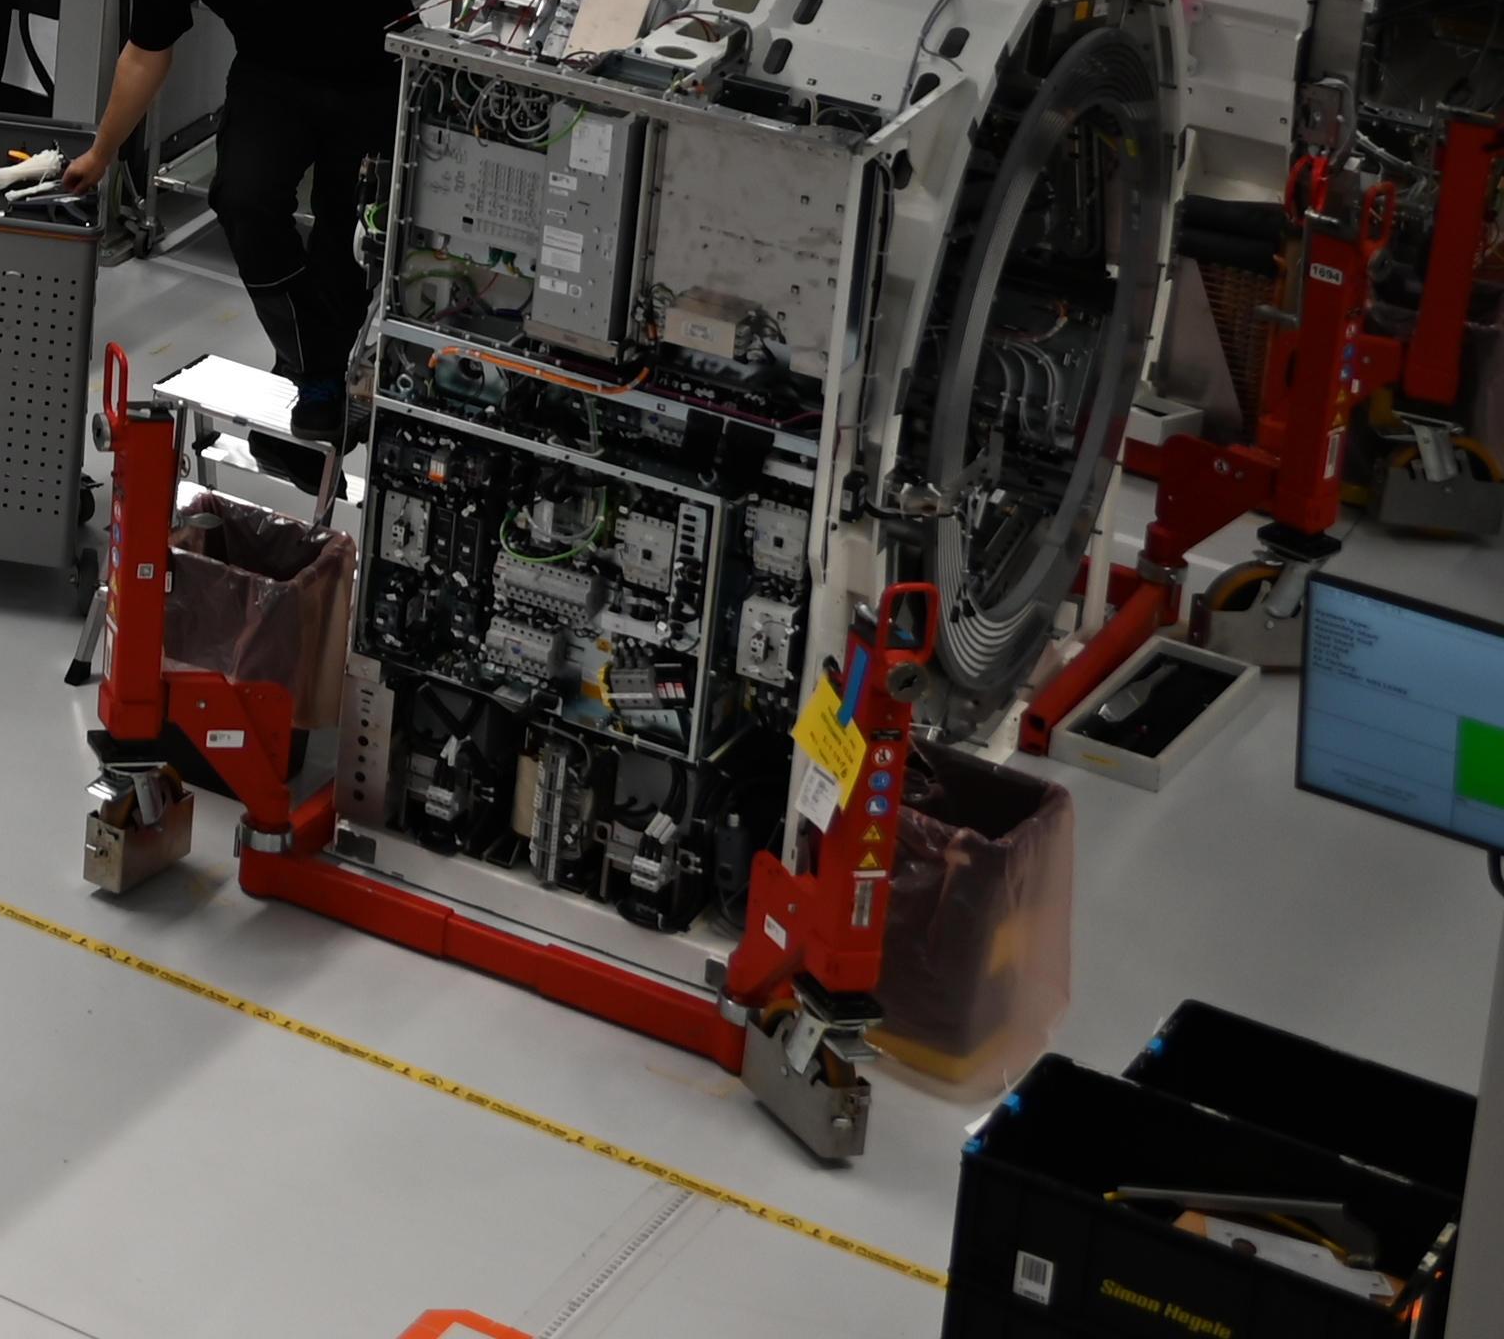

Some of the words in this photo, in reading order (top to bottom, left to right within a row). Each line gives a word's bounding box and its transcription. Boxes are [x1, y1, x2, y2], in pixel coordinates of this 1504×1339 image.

[1313, 265, 1340, 282] 1694
[5, 909, 49, 932] Protected
[159, 970, 205, 994] Protected
[322, 1034, 369, 1058] Protected
[491, 1102, 541, 1127] Protected
[668, 1171, 721, 1198] Protected
[855, 1244, 911, 1273] Protected
[1099, 1278, 1162, 1313] Simon
[1163, 1302, 1232, 1339] Hegele
